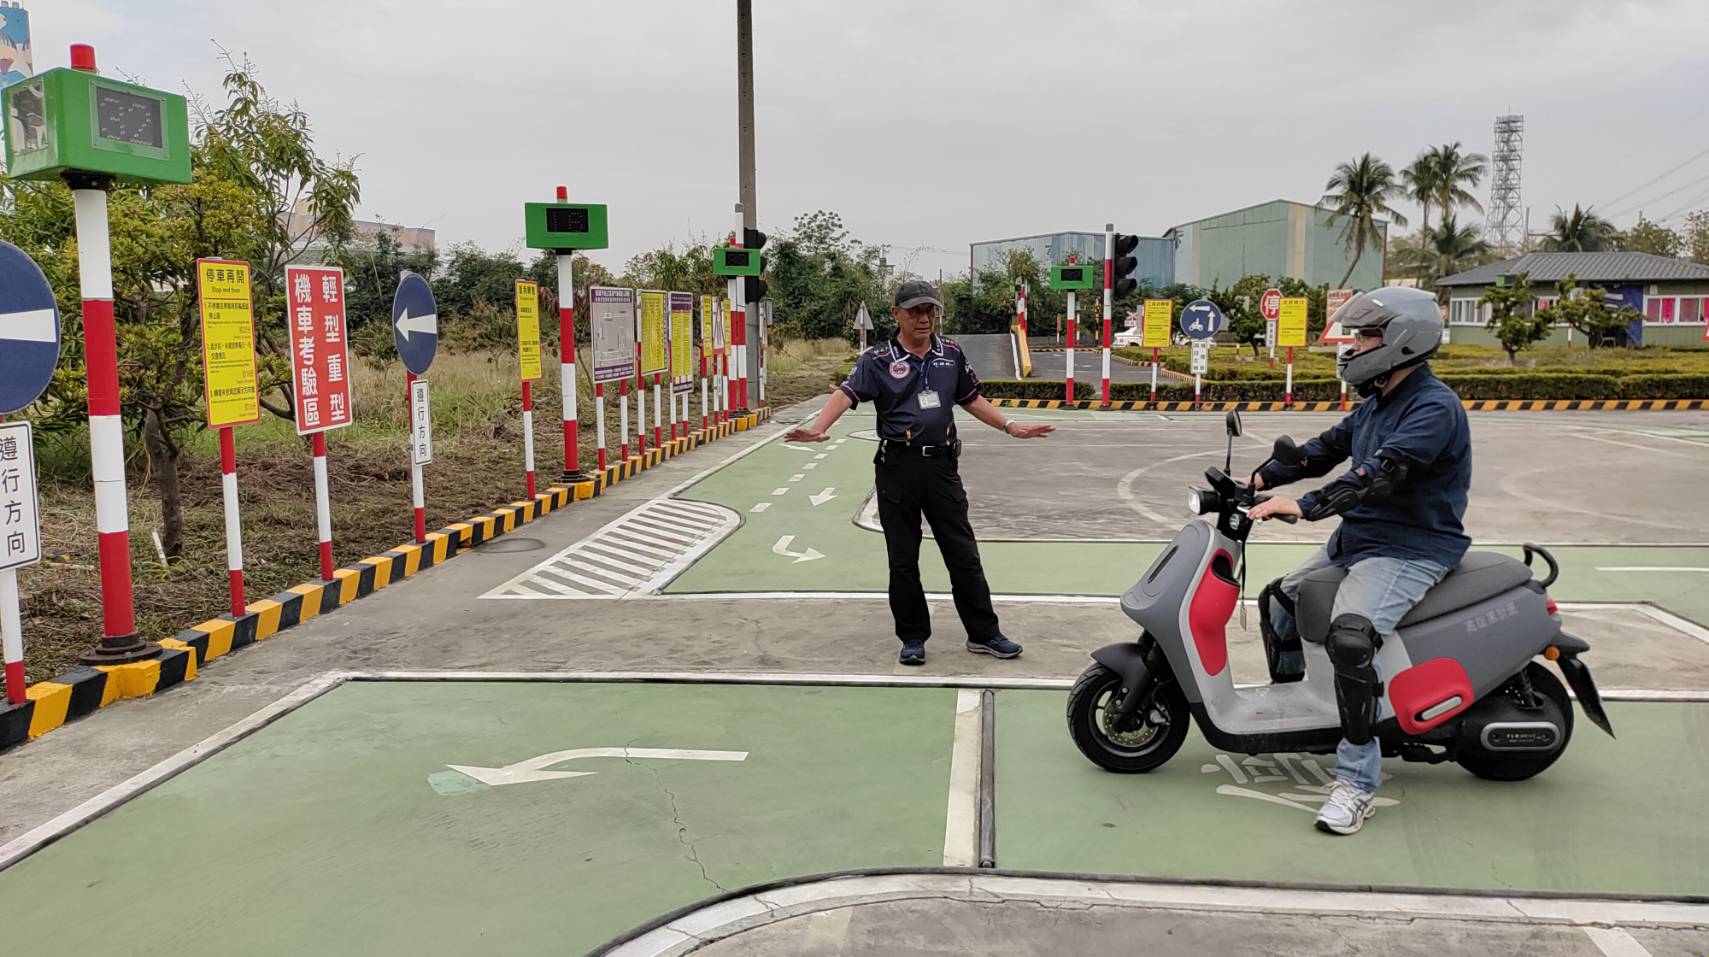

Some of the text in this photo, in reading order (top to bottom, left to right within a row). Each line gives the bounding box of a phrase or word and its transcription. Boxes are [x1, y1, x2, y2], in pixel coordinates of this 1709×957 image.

[206, 268, 245, 284] 停車再開
[1264, 294, 1281, 316] 停
[294, 273, 320, 426] 機車考驗區
[321, 274, 346, 422] 輕型重型
